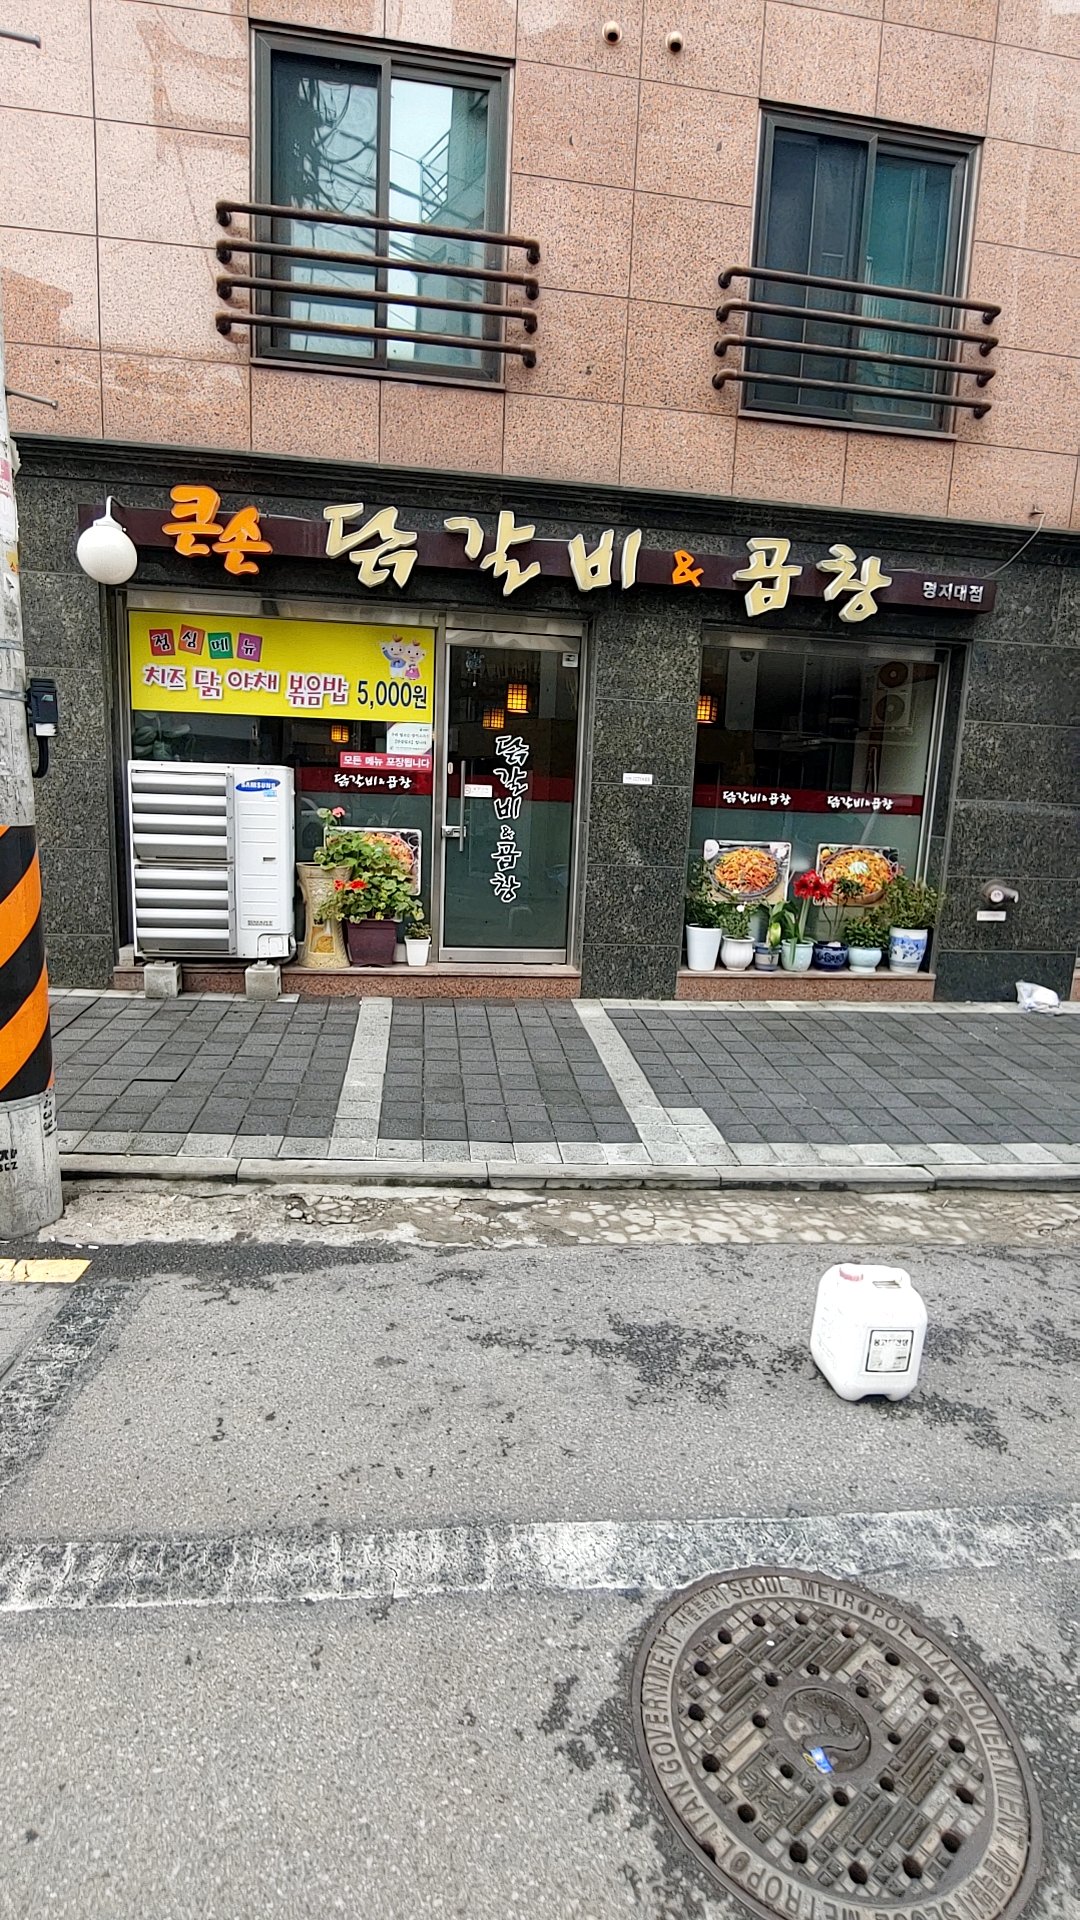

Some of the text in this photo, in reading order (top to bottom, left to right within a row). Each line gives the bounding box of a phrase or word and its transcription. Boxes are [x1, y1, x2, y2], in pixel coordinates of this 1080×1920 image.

[161, 484, 985, 623] 큰손 닭갈비 & 곱창 명지대점
[143, 665, 428, 710] 치즈 닭 야채 볶음밥 5,000원
[151, 627, 260, 659] 점심메뉴
[343, 755, 431, 769] 모든 메뉴 포장됩니다
[643, 1622, 682, 1775] GOVERNMENT
[727, 1575, 791, 1600] SEOUL
[800, 1580, 967, 1687] METROPOLITAN
[959, 1689, 1028, 1851] GOVERNMENT
